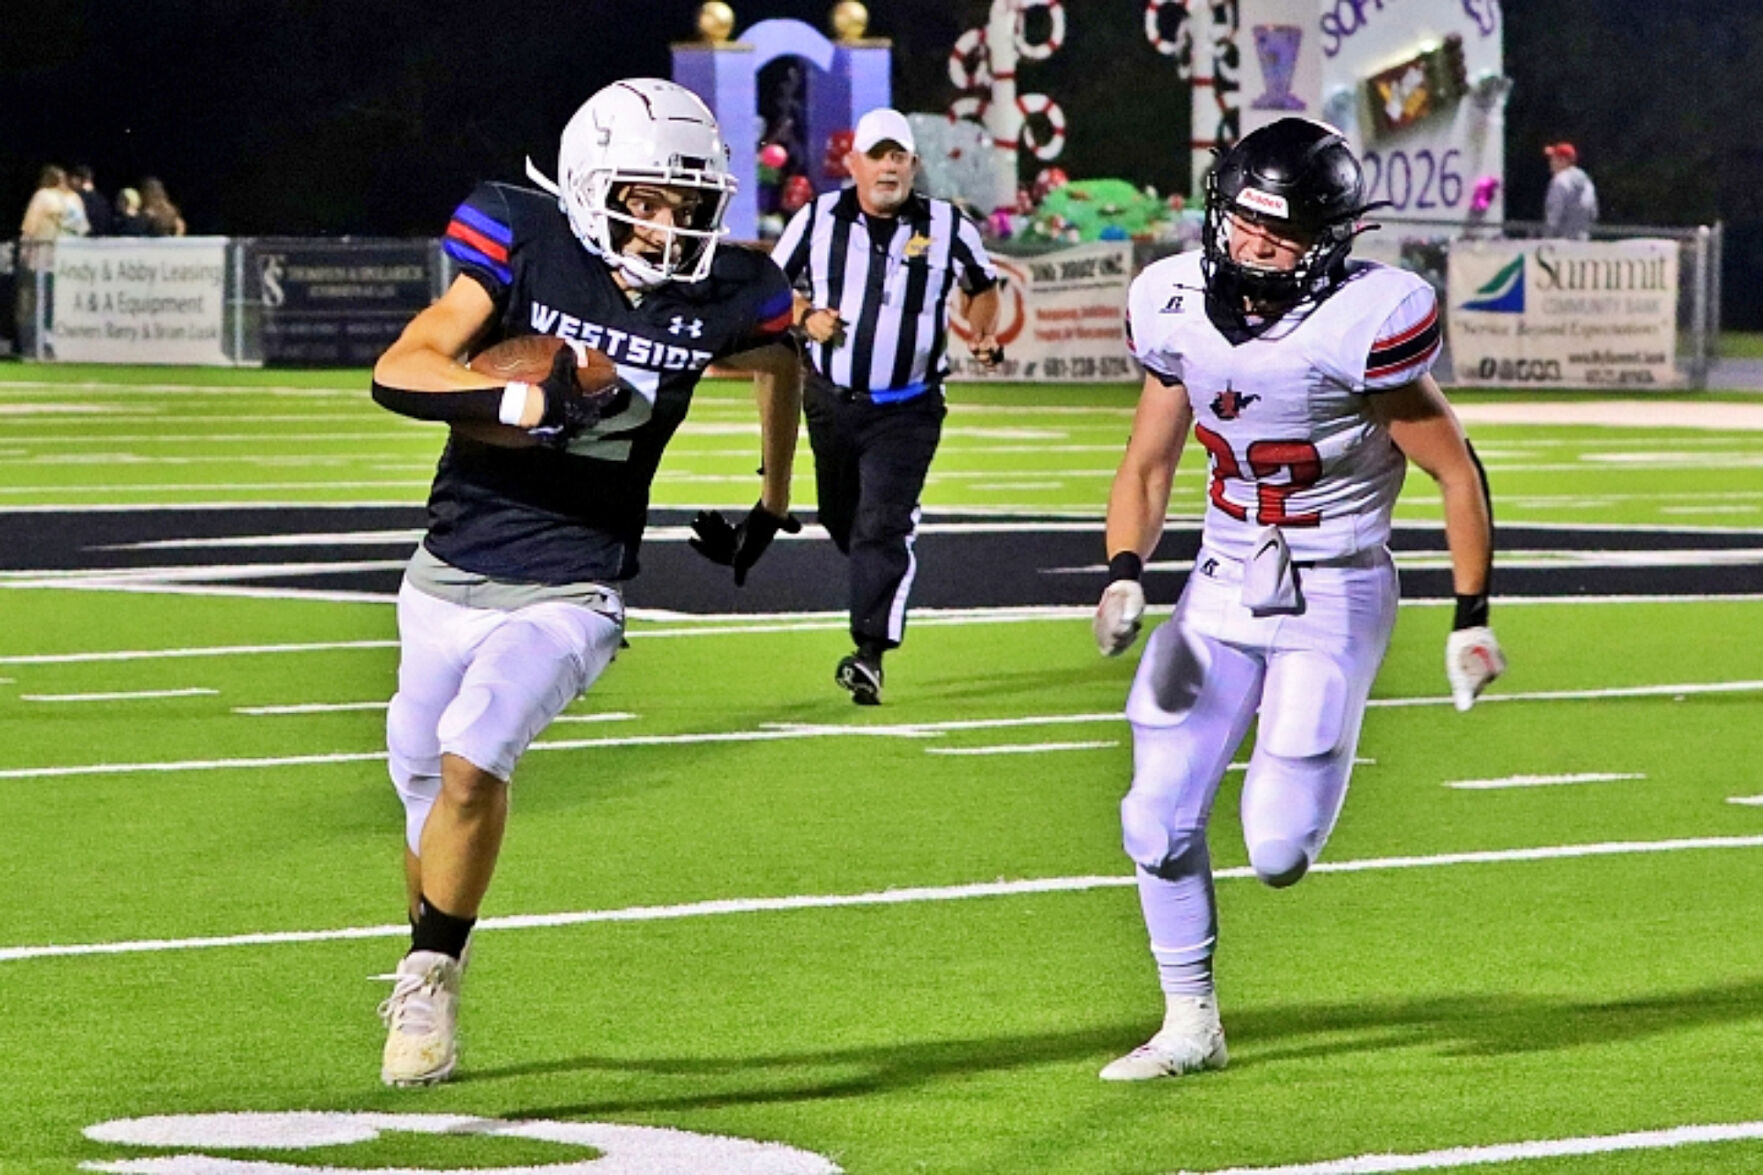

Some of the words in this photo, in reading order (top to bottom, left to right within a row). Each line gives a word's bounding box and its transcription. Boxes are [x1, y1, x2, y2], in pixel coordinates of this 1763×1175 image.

[1362, 149, 1463, 211] 2026
[116, 260, 157, 286] Abby
[1535, 244, 1667, 291] Summit
[117, 291, 204, 318] Equipment
[1194, 421, 1323, 528] 22
